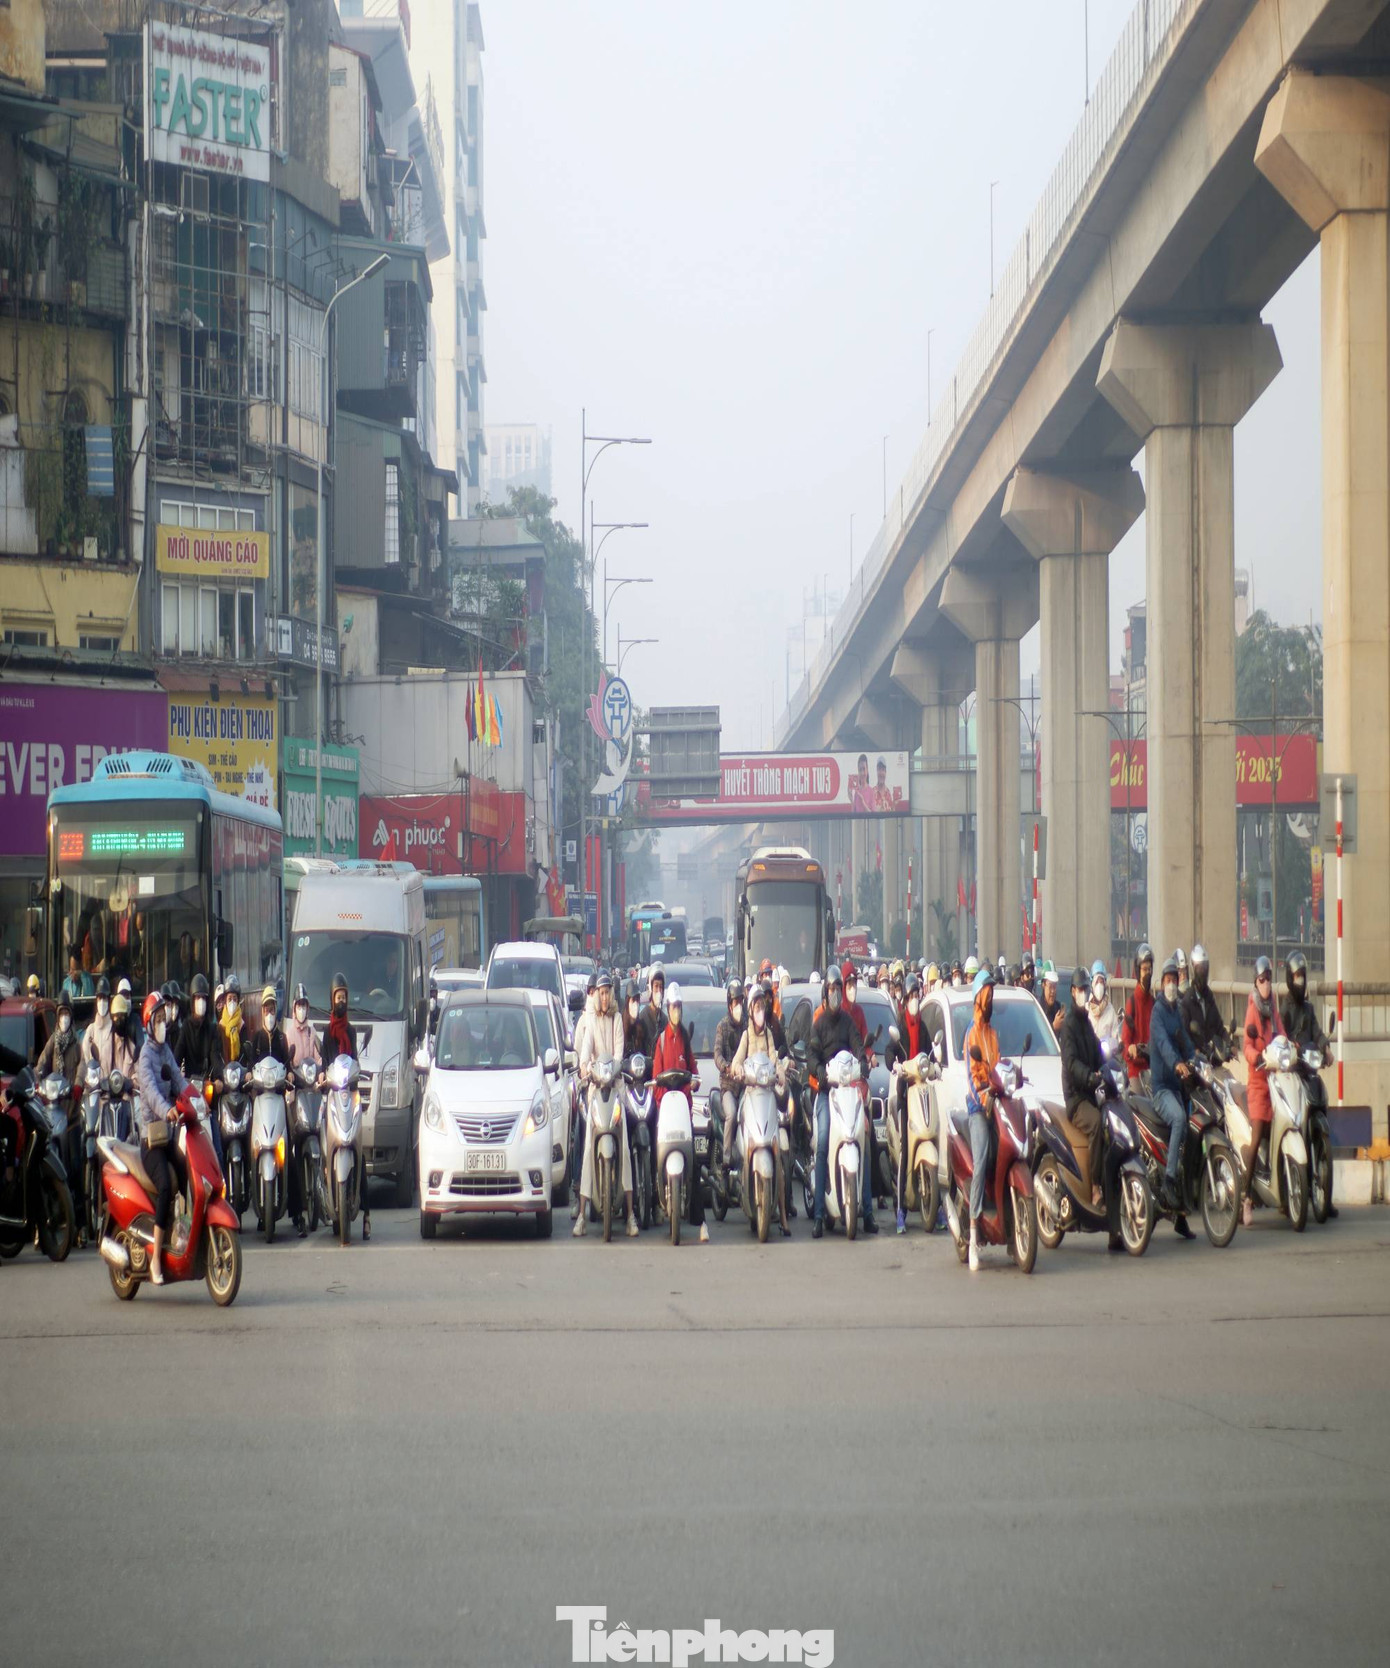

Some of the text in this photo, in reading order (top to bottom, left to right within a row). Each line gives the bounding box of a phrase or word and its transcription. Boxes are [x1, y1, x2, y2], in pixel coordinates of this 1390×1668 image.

[154, 67, 262, 148] FASTER
[167, 532, 258, 564] MỜI QUẢNG CÁO
[170, 700, 274, 748] PHỤ KIỆN ĐIỆN THOẠI
[724, 760, 831, 801] HUYẾT THÔNG MẠCH TW3
[1110, 751, 1144, 787] Chúc
[1249, 756, 1283, 783] 2025
